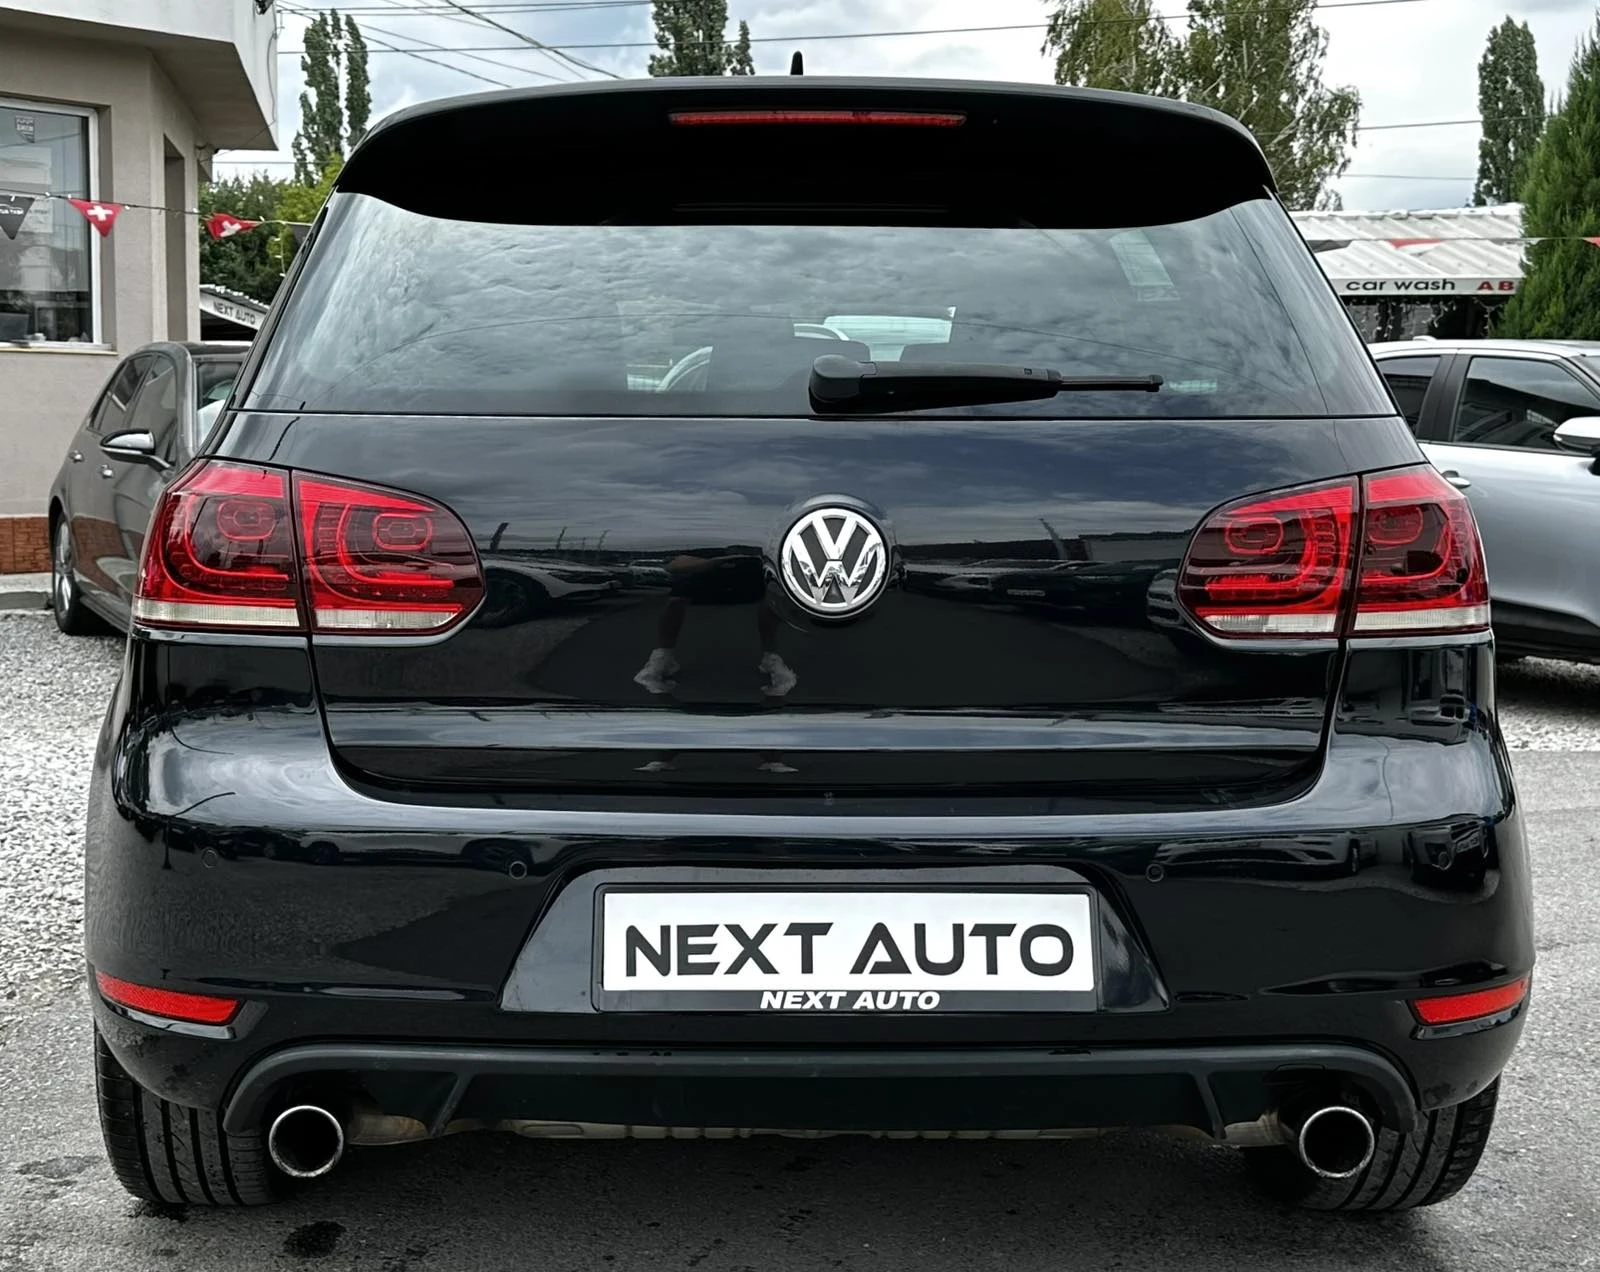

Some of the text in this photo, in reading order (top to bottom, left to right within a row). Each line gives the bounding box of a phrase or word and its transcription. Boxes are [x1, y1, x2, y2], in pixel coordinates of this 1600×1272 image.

[1346, 279, 1455, 291] car wash
[235, 309, 255, 325] AUTO
[626, 923, 1073, 976] NEXT AUTO
[760, 990, 940, 1010] NEXT AUTO
